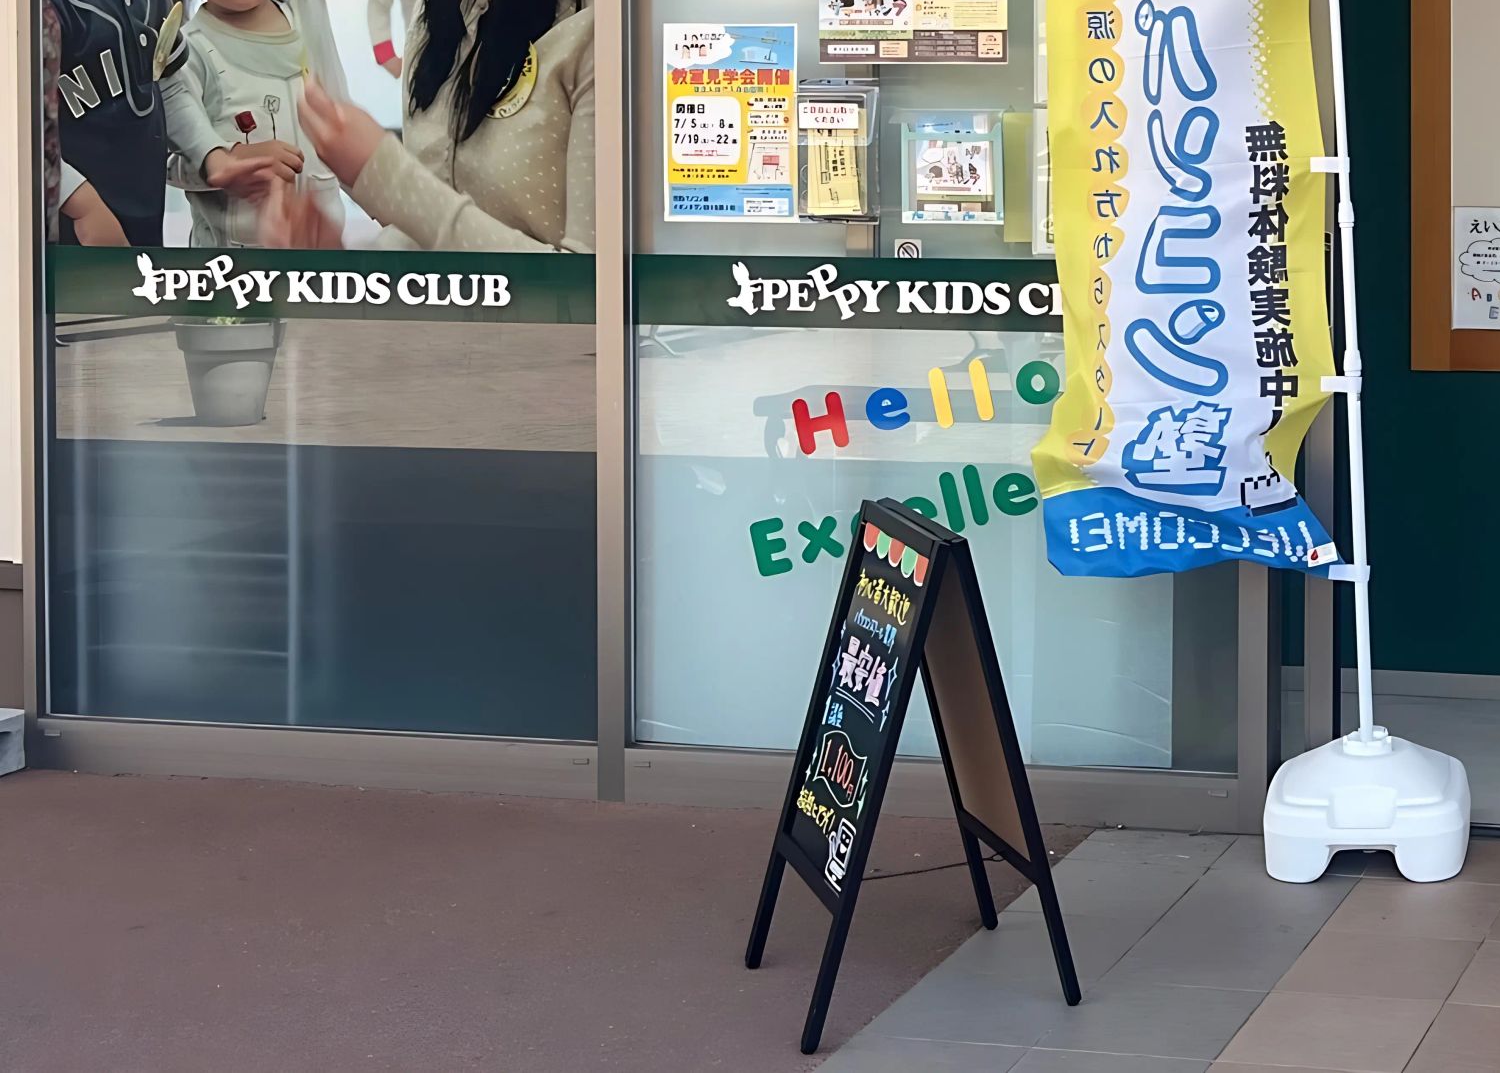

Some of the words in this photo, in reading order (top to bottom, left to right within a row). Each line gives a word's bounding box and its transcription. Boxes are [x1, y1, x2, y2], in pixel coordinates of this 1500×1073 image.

[159, 255, 281, 309] PEPPY
[287, 271, 390, 305] KIDS
[398, 273, 511, 308] CLUB
[760, 263, 890, 320] PEPPY
[896, 280, 1011, 316] KIDS
[1018, 282, 1064, 316] CL
[791, 358, 1061, 455] Hello
[749, 464, 1039, 578] Exlle
[839, 635, 887, 707] 最安値
